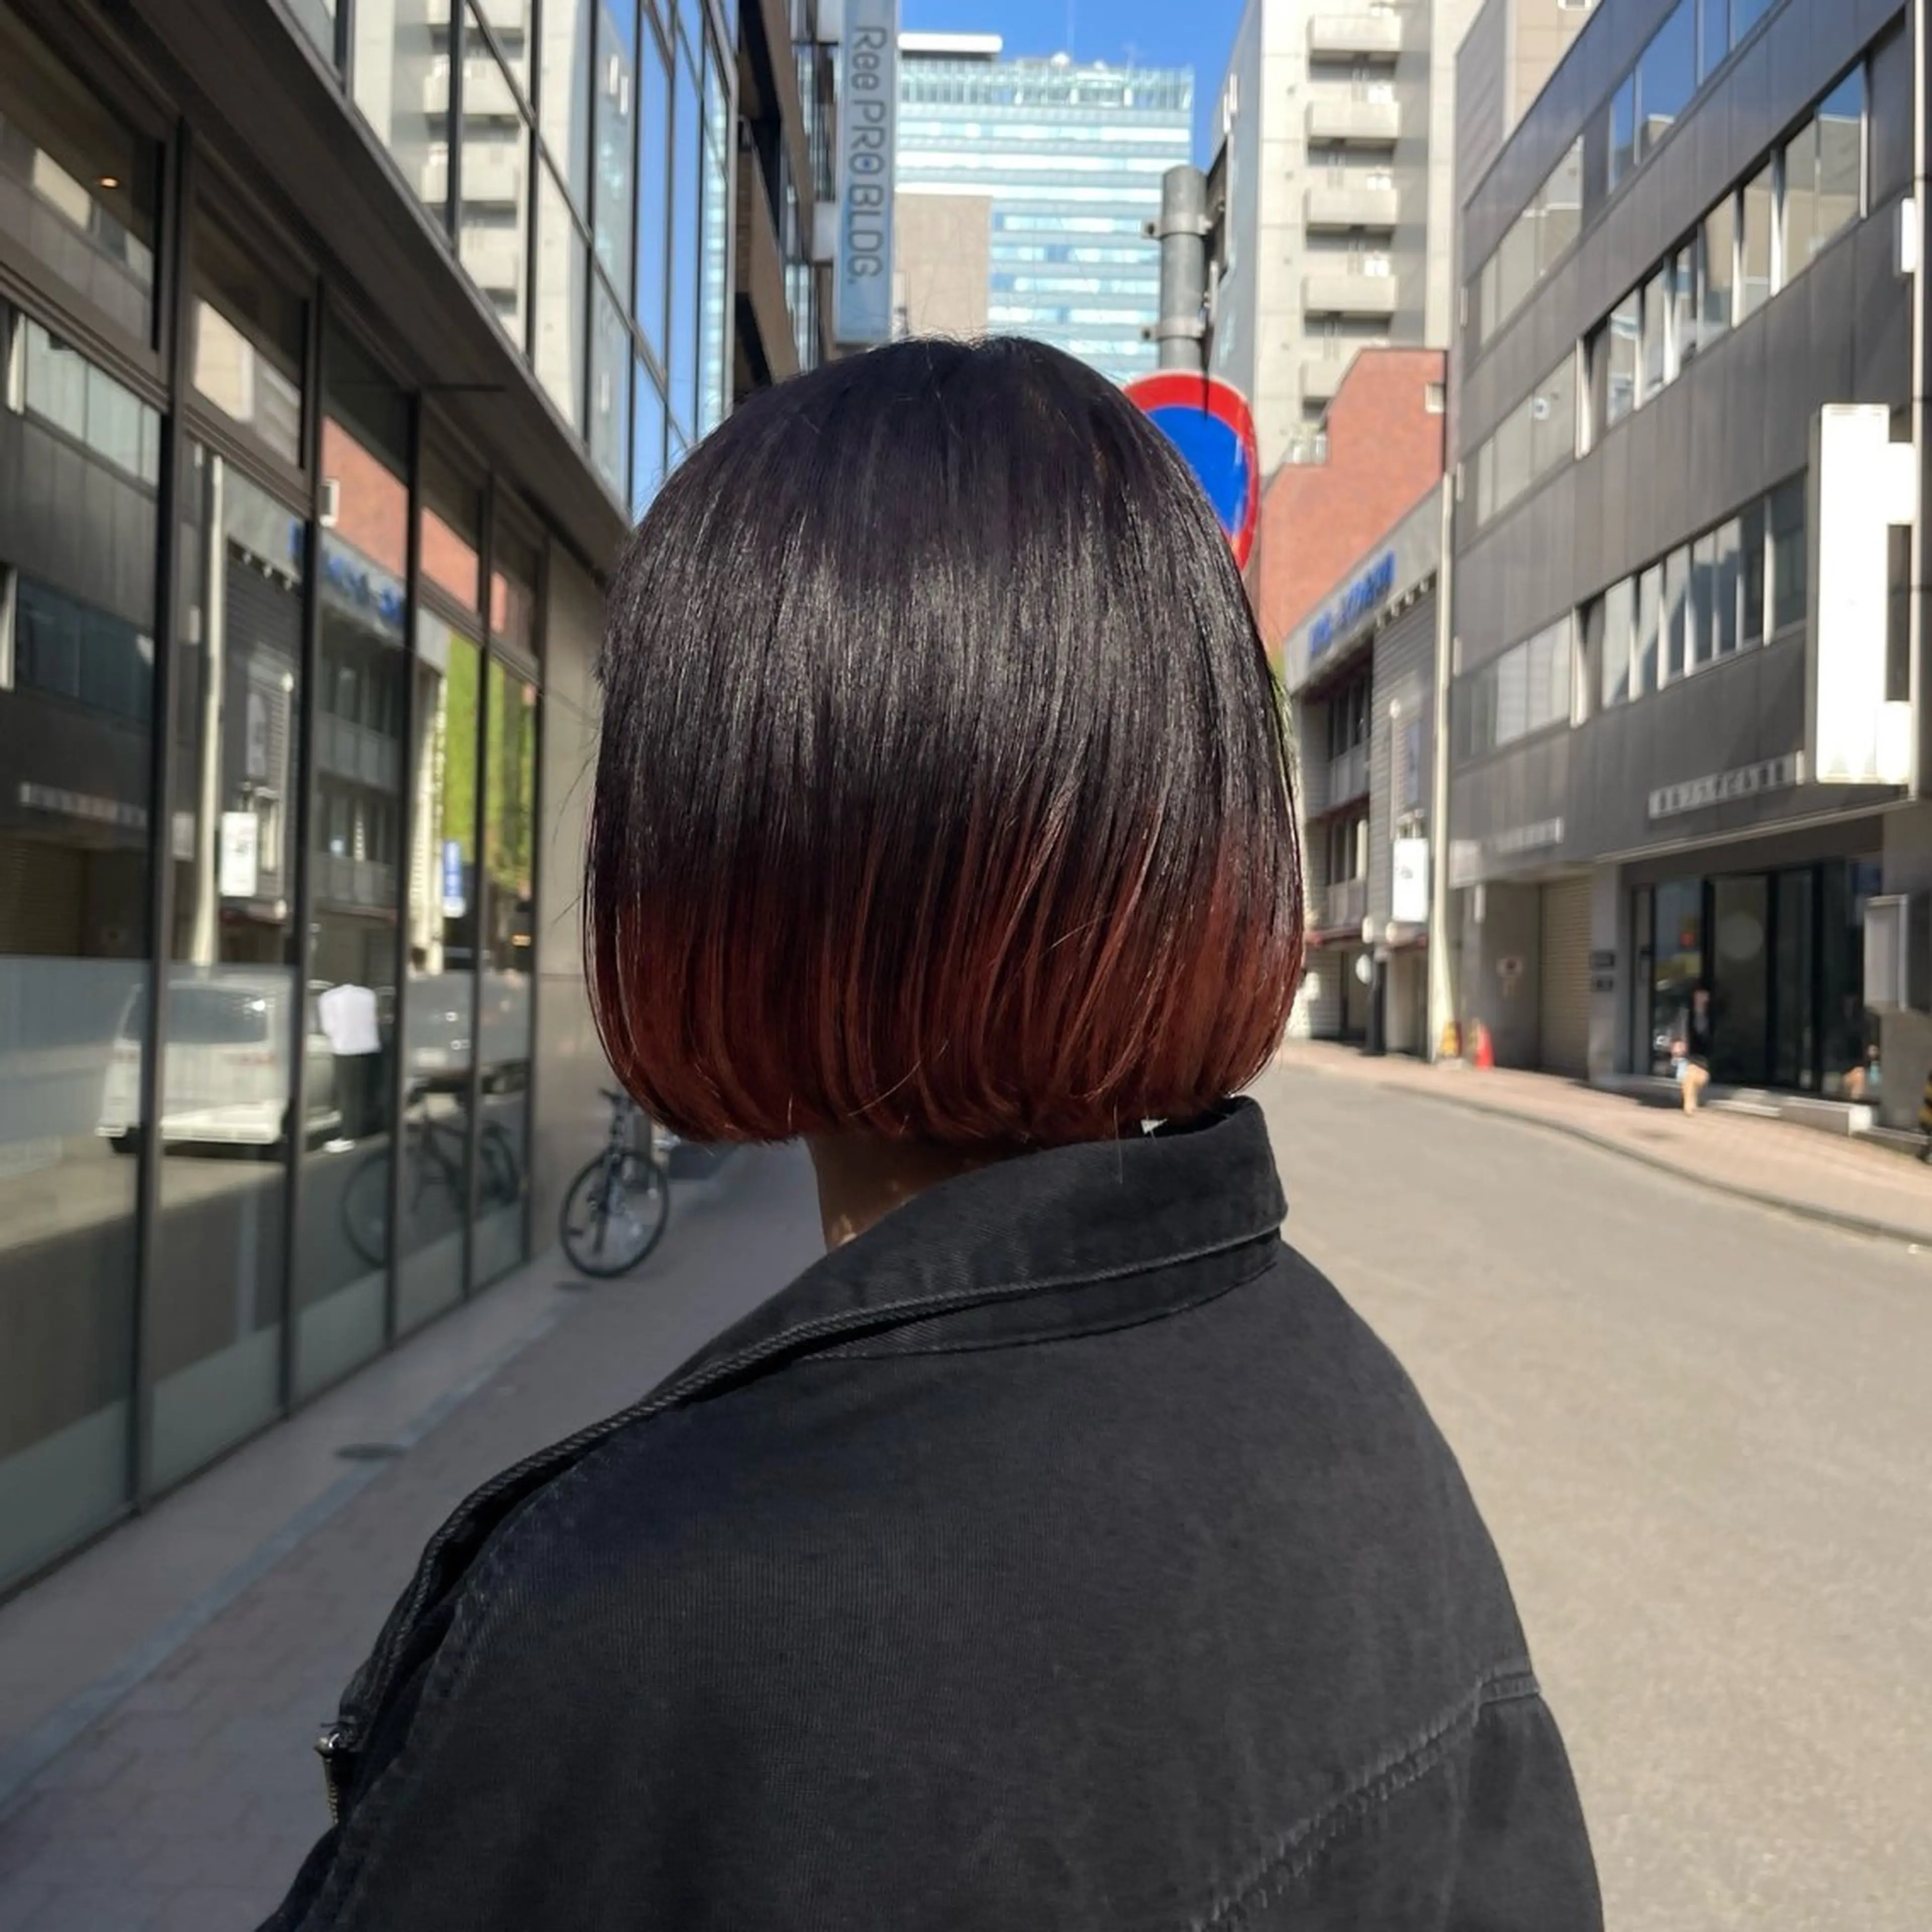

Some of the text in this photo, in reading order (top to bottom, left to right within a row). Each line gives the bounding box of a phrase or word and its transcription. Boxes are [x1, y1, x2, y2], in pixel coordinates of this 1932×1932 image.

[847, 26, 887, 285] Ree PRO BLDG.
